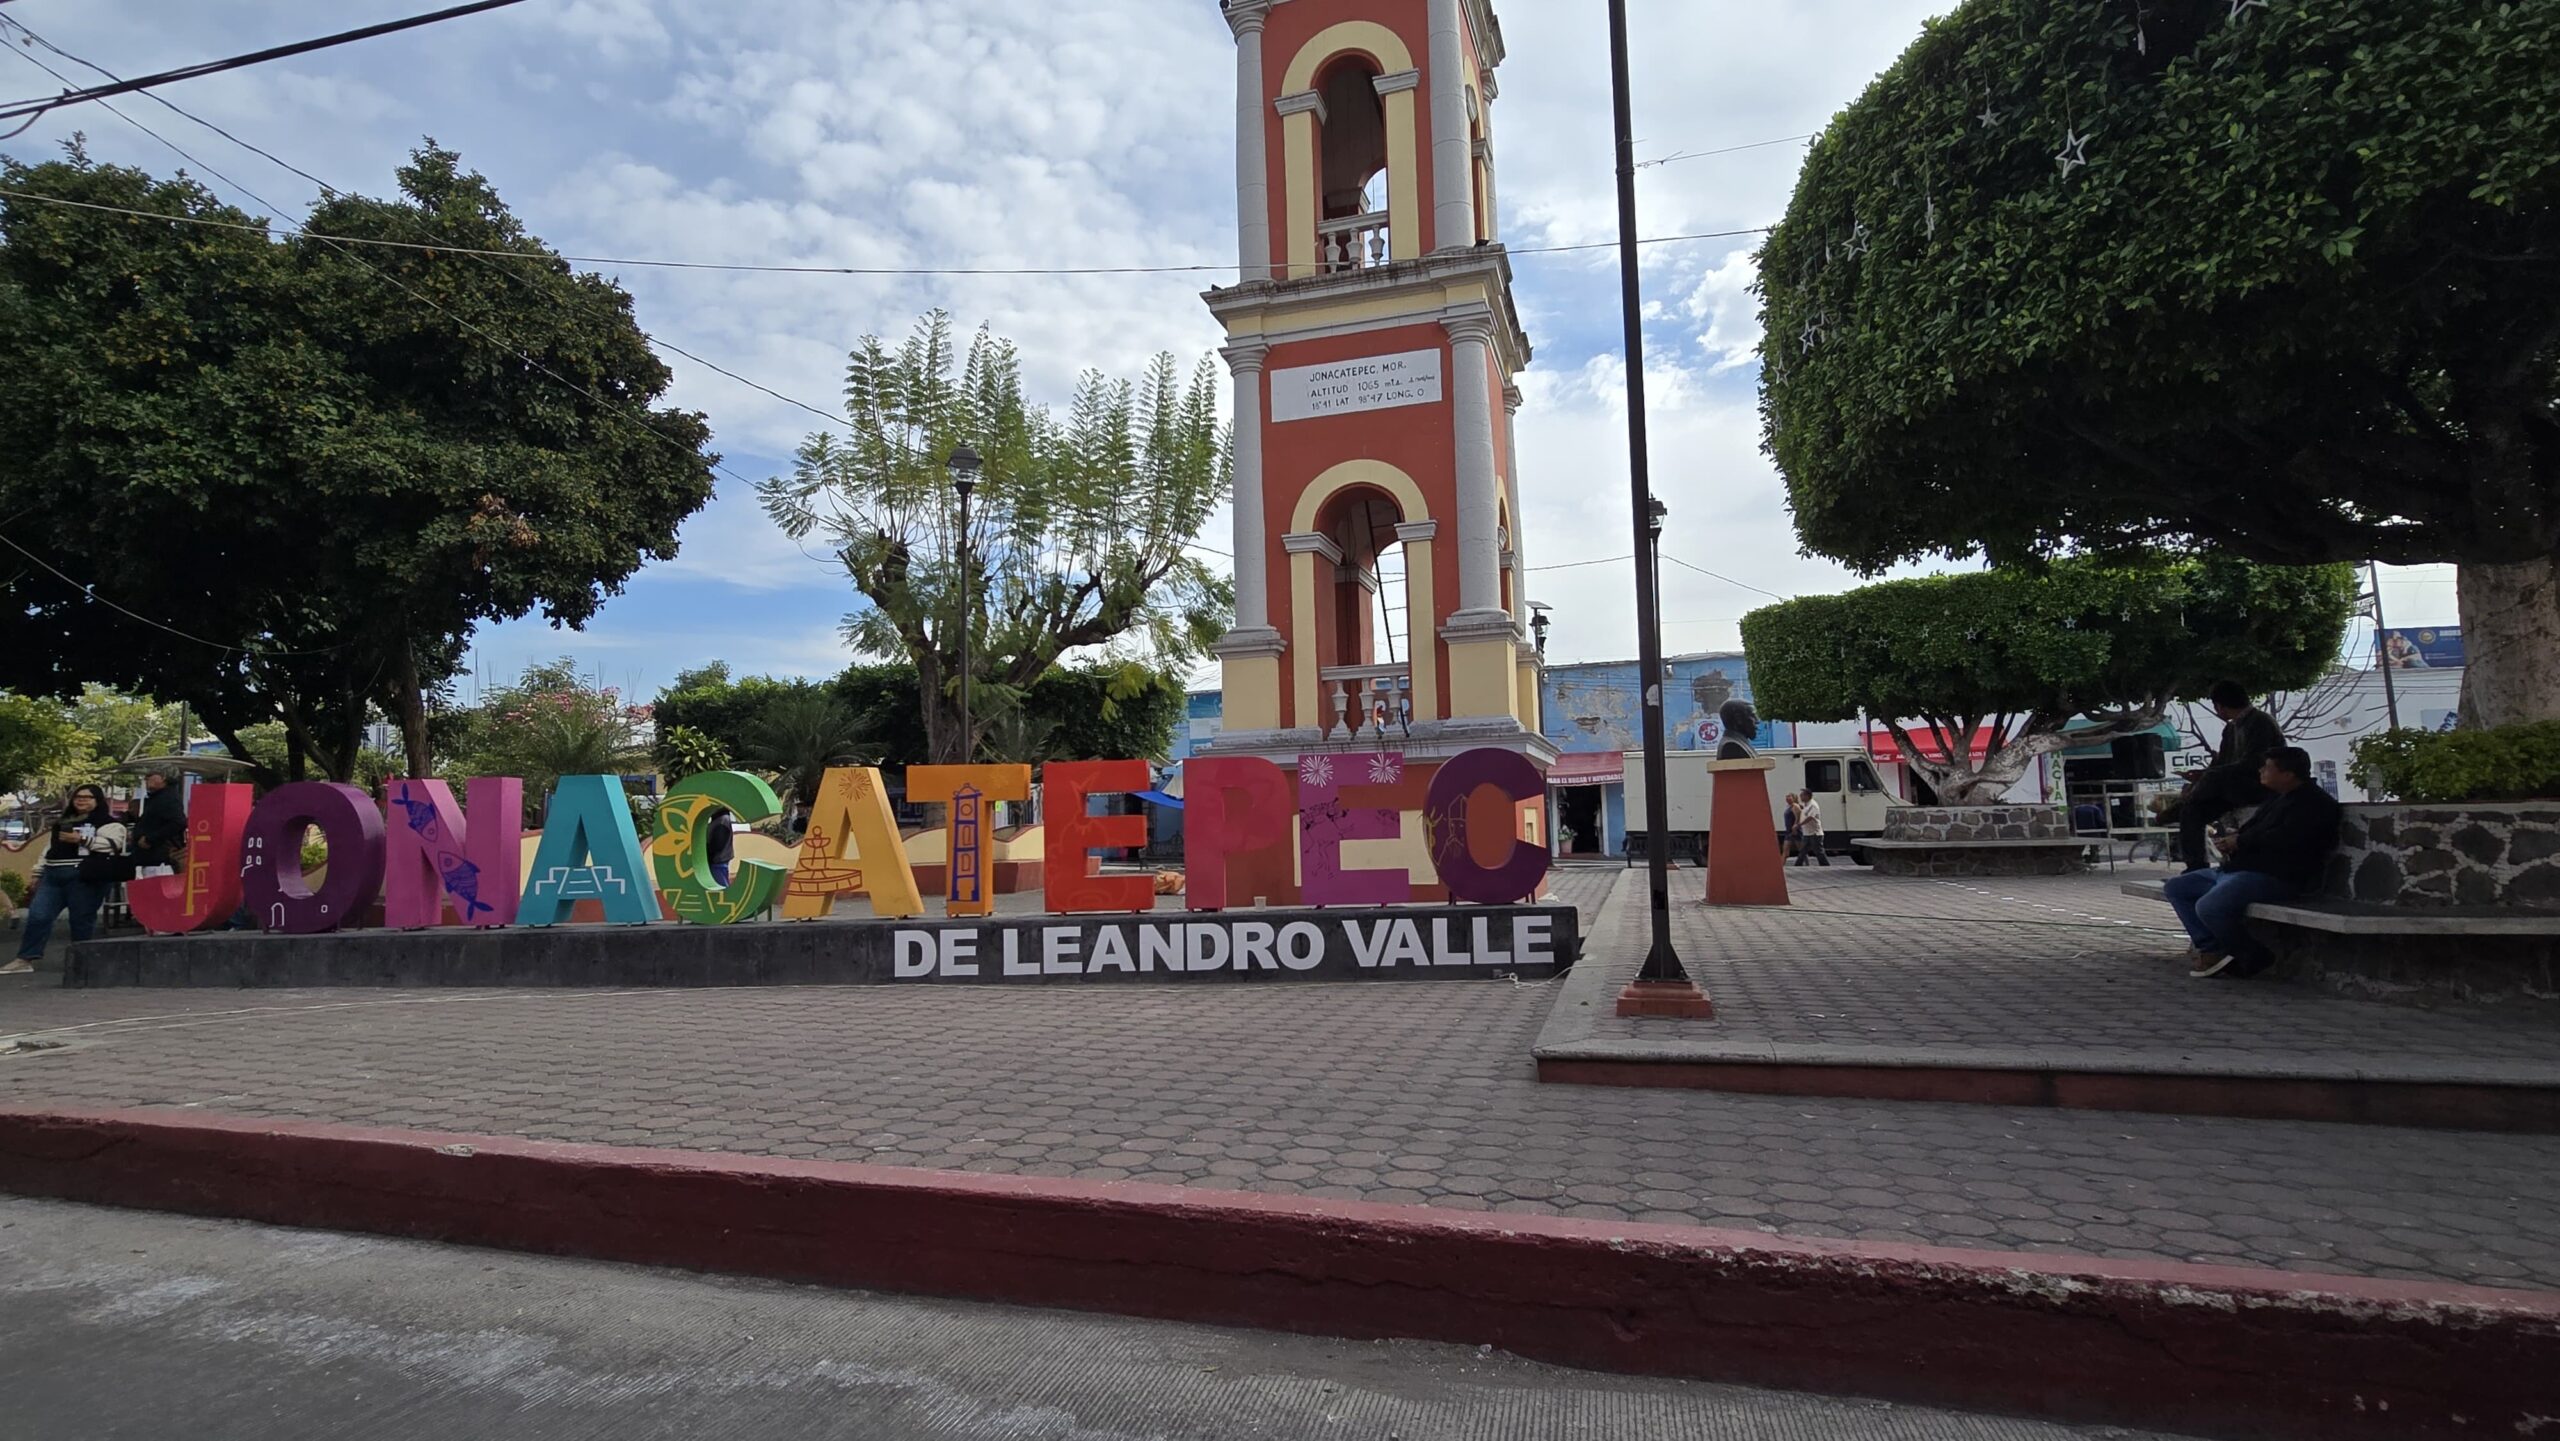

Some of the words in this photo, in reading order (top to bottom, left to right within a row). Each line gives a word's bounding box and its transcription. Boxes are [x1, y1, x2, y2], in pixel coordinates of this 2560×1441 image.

[1382, 360, 1407, 372] MOR.
[1311, 385, 1349, 398] ALTITUD
[127, 748, 1552, 934] JONACATEPEC
[894, 928, 979, 977] DE
[1002, 921, 1325, 976] LEANDRO
[1341, 915, 1555, 967] VALLE
